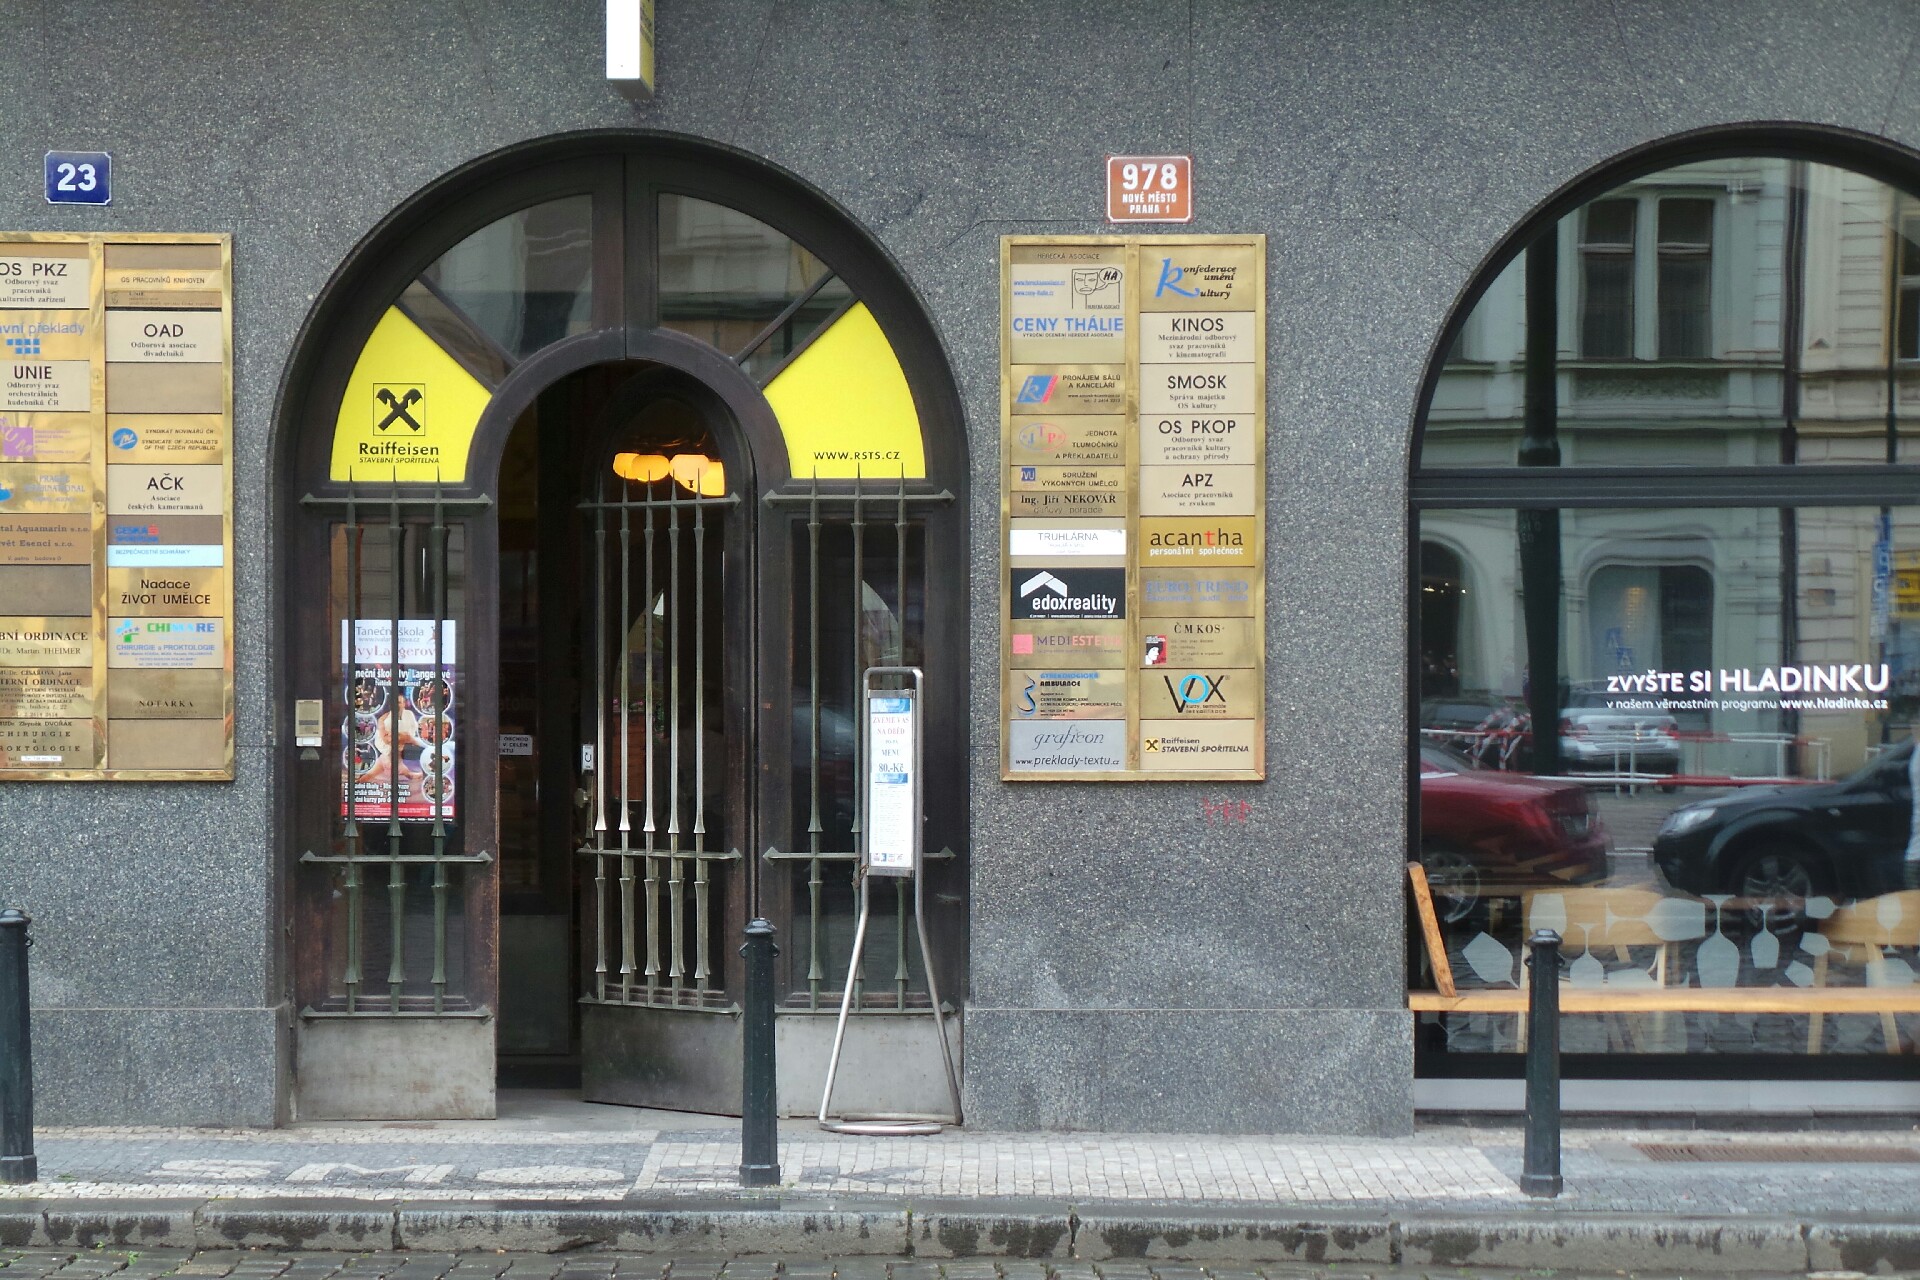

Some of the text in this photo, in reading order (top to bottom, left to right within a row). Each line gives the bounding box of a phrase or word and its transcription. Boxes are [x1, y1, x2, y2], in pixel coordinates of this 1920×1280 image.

[57, 163, 97, 191] 23
[1122, 163, 1178, 191] 978
[1122, 191, 1177, 203] NOVÉ MĚSTO
[1129, 204, 1170, 214] PRAHA 1
[1037, 252, 1066, 260] HERECKÁ
[32, 262, 68, 277] PKZ
[132, 275, 171, 283] PRACOVNÍKŮ
[1103, 270, 1118, 281] HA
[1204, 273, 1236, 281] umění
[5, 278, 40, 286] Odborový
[1013, 315, 1124, 332] CENY THÁLIE
[1171, 318, 1224, 332] KINOS
[28, 322, 84, 336] překlady
[143, 323, 184, 338] OAD
[1204, 334, 1237, 342] odborový
[131, 341, 165, 349] Odborová
[1176, 351, 1227, 359] kinematografii
[14, 366, 52, 379] UNIE
[1102, 373, 1121, 381] SÁLŮ
[1167, 375, 1227, 389] SMOSK
[48, 398, 59, 406] ČR
[1169, 393, 1226, 401] Správa majetku
[1192, 402, 1218, 410] kultury
[1158, 420, 1236, 434] OS PKOP
[359, 441, 440, 456] Raiffeisen
[1072, 440, 1118, 448] TLUMOČNÍKŮ
[1163, 444, 1231, 453] pracovníků kultury
[359, 456, 440, 464] STAVEBNÍ SPOŘITELNA
[813, 451, 901, 460] WWW.RSTS.CZ
[1172, 453, 1230, 461] ochrany přírody
[147, 472, 184, 490] AČK
[1182, 474, 1213, 487] APZ
[1021, 493, 1117, 505] Ing. Jiří NEKOVÁŘ
[1194, 491, 1233, 499] pracovníků
[127, 503, 154, 511] českých
[1069, 506, 1103, 514] poradce
[16, 525, 67, 533] Aquamarin
[1038, 532, 1099, 541] TRUHLÁRNA
[1150, 527, 1244, 546] acantha
[1149, 546, 1244, 556] personální společnost
[140, 579, 191, 589] Nadace
[121, 592, 211, 605] ŽIVOT UMĚLCE
[1032, 594, 1117, 614] edoxreality
[356, 626, 425, 636] Tanečn škola
[24, 632, 88, 641] ORDINACE
[16, 647, 40, 655] Martin
[32, 678, 82, 686] ORDINACE
[1606, 663, 1889, 692] ZVYŠTE SI HLADINKU
[1615, 698, 1654, 709] našem
[1655, 698, 1719, 709] věrnostním
[1721, 700, 1778, 712] programu
[1779, 699, 1889, 710] www.hladinka.cz
[1161, 744, 1250, 753] STAVEBNÍ SPOŘITELNA
[1015, 754, 1120, 768] www.preklady-textu.cz
